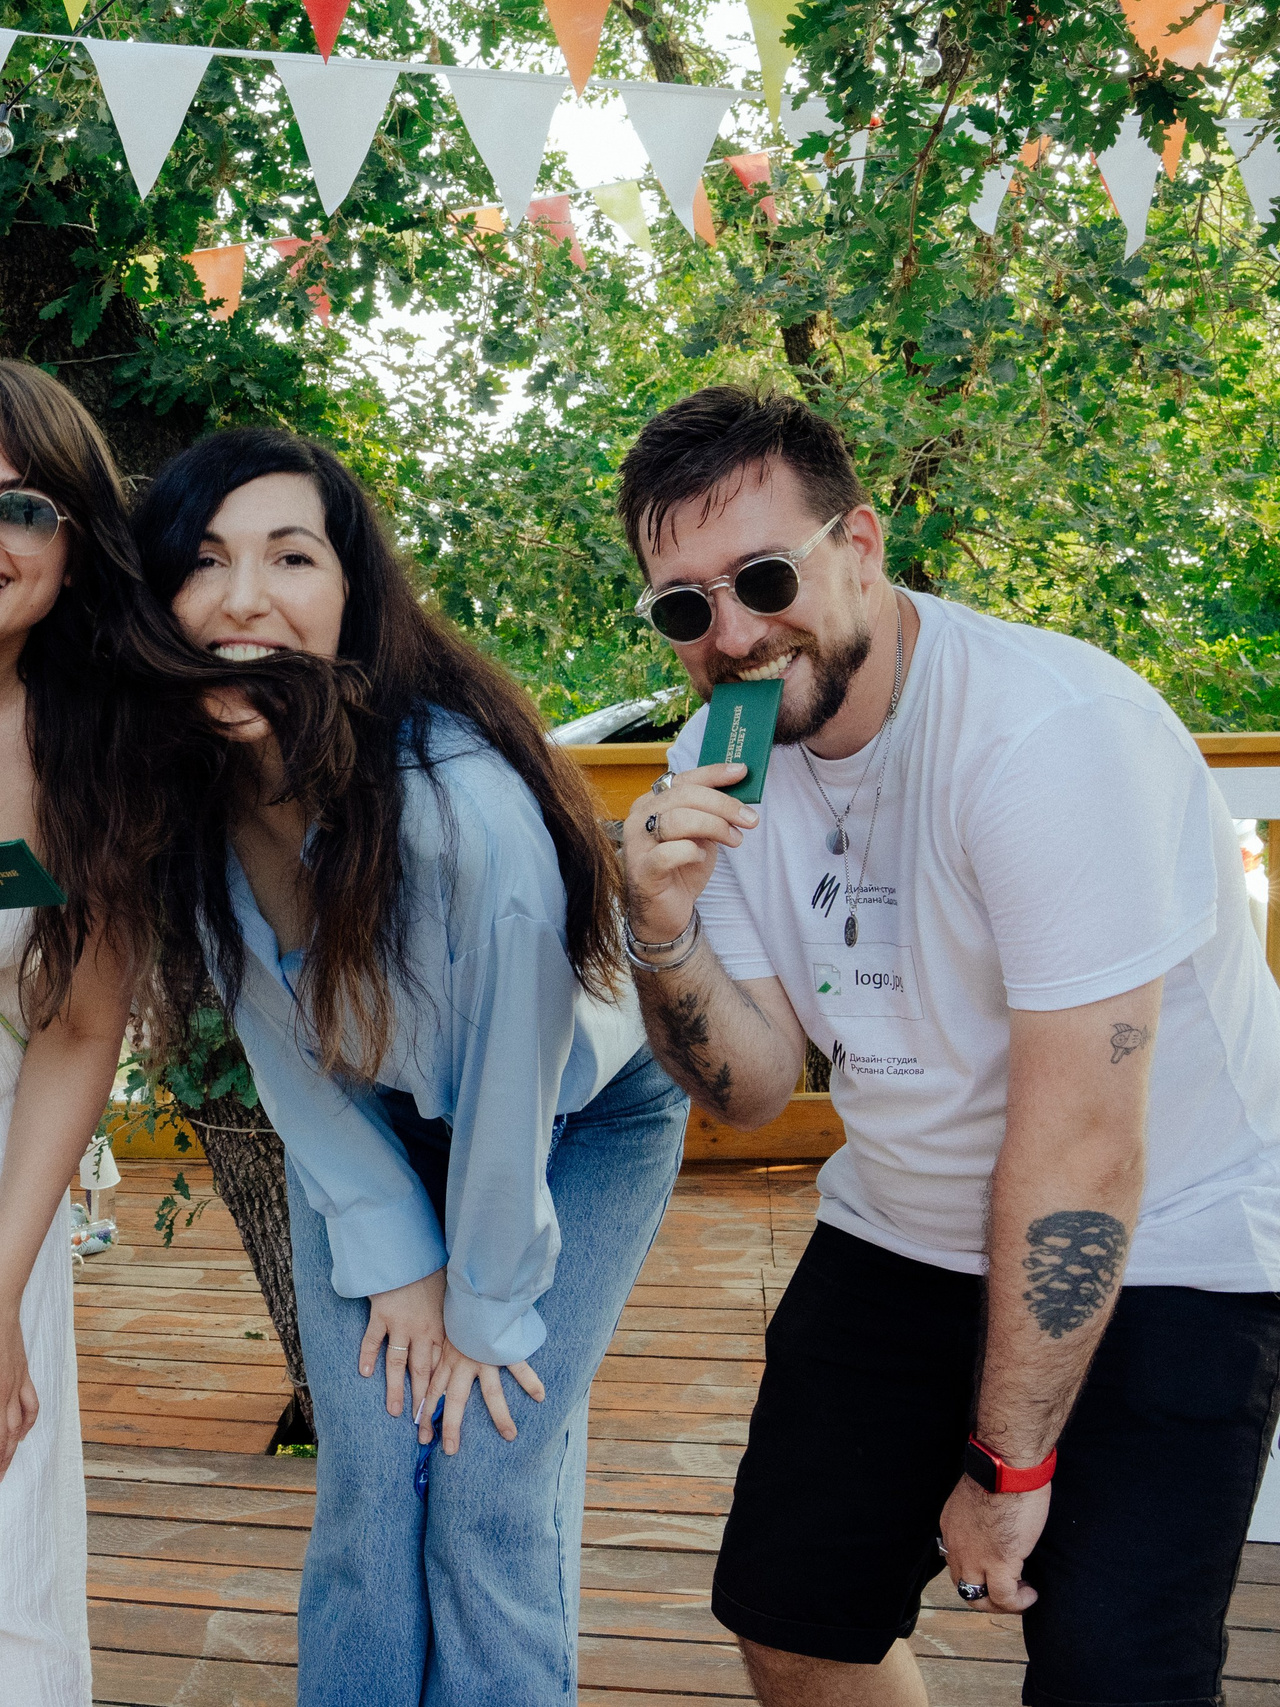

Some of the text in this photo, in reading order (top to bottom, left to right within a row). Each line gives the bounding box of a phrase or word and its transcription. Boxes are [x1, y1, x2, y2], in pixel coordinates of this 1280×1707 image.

[725, 704, 743, 764] ДЕНЧЕСКИЙ
[734, 726, 746, 758] БИЛЕТ
[849, 1053, 918, 1066] Дизайн-студия
[851, 1063, 925, 1076] Руслана Садкова
